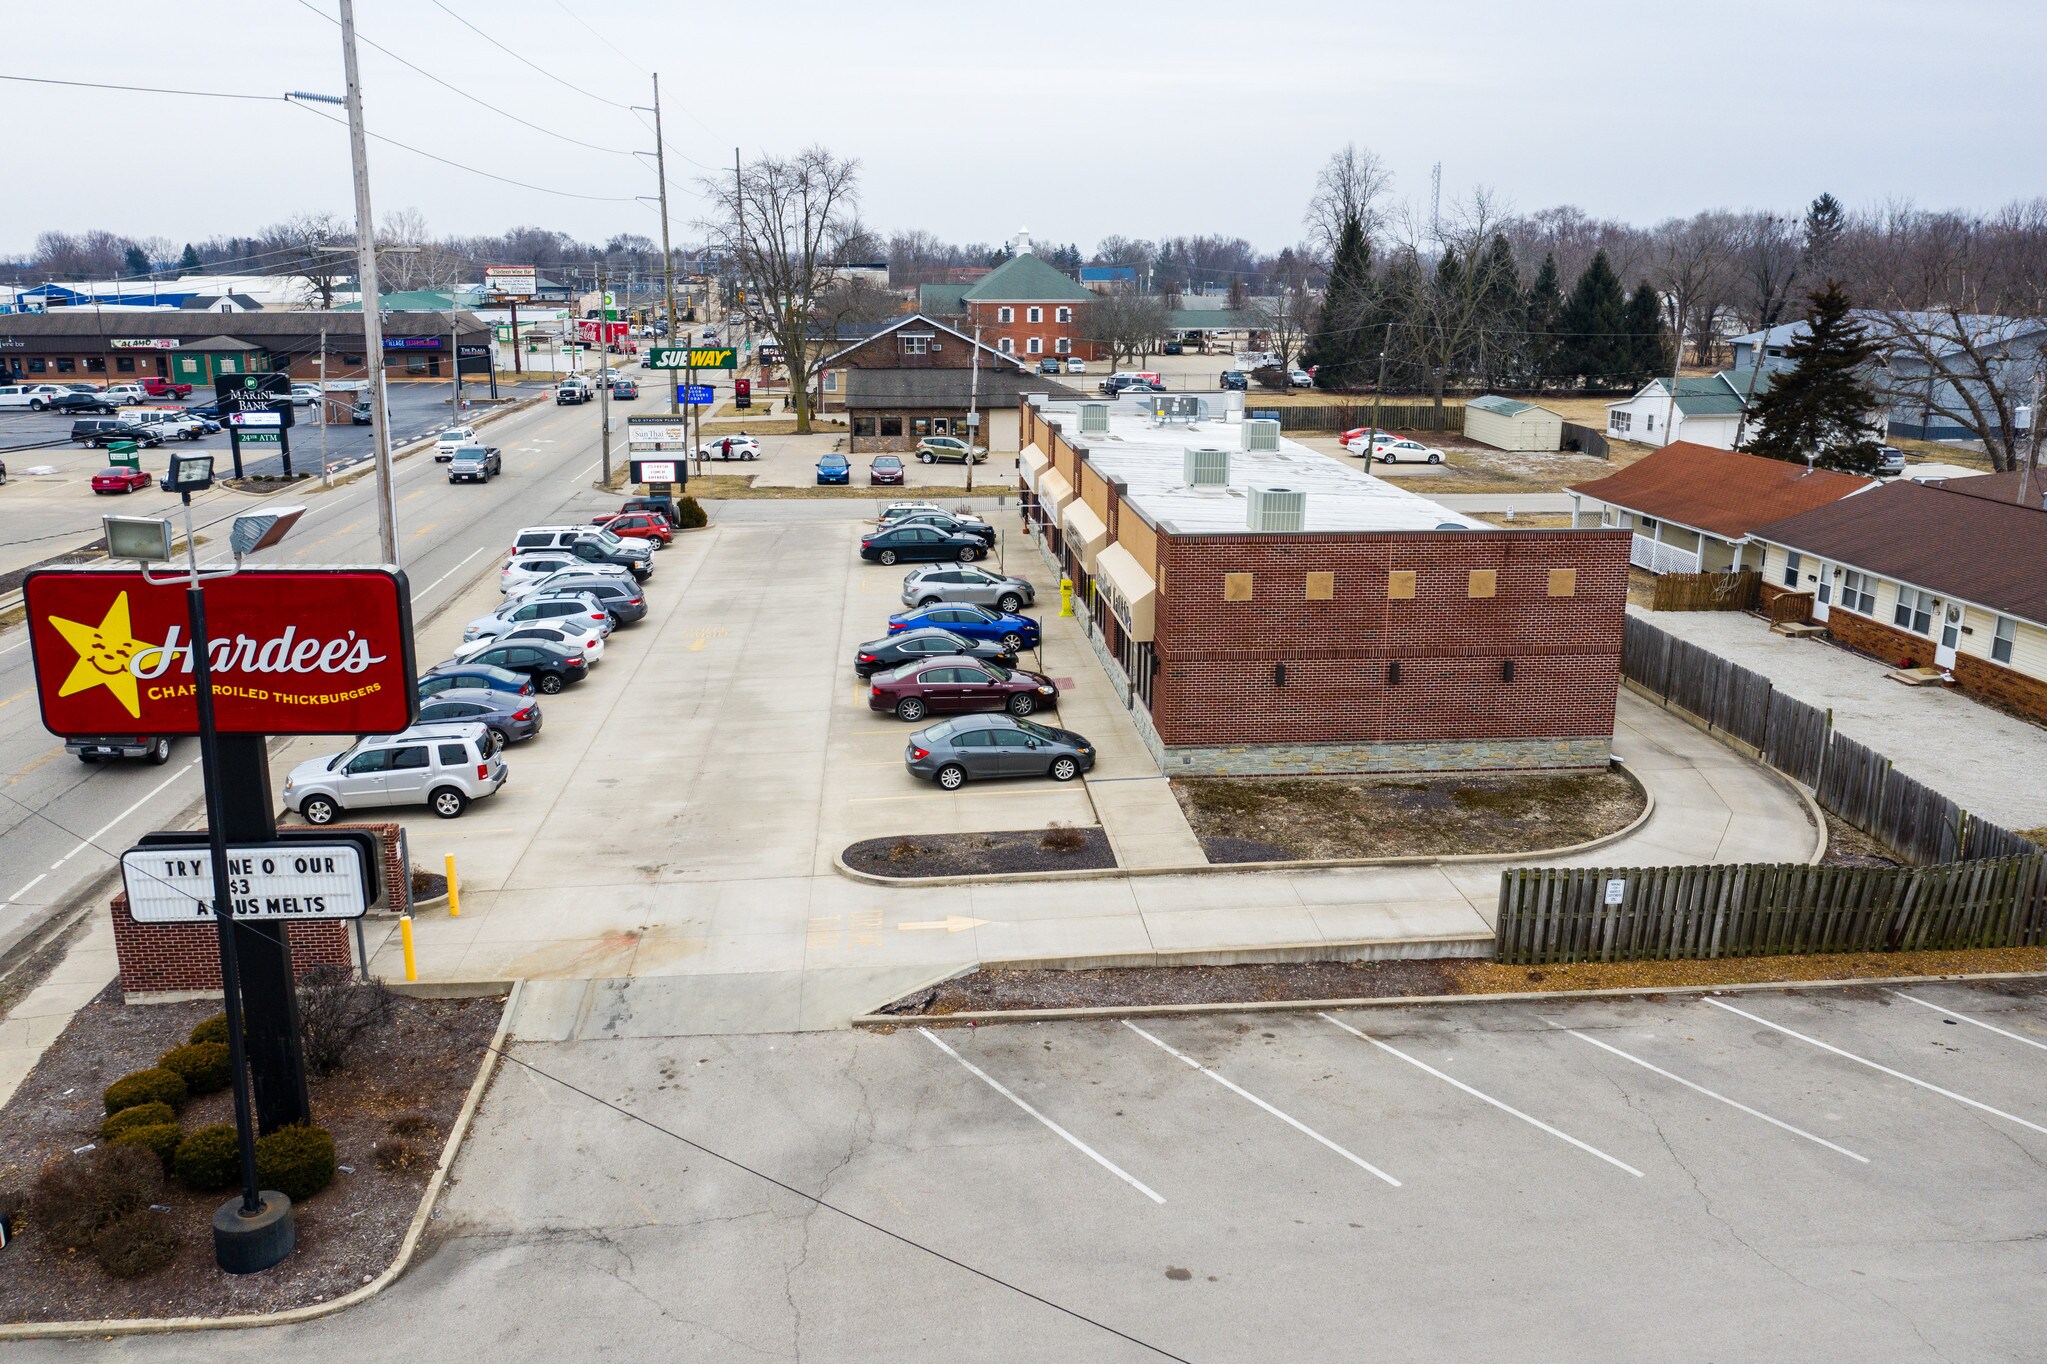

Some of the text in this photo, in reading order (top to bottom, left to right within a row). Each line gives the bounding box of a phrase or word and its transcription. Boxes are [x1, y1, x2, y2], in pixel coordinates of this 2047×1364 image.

[121, 339, 151, 347] ALAMO
[656, 350, 731, 367] SUBWAY
[230, 390, 274, 400] MARINE
[239, 400, 269, 411] BANK
[635, 430, 649, 438] Sun
[129, 625, 387, 680] Hardee's
[273, 682, 382, 705] THICKBURGERS
[165, 860, 202, 877] TRY
[228, 859, 253, 876] NE
[295, 857, 335, 874] OUR
[230, 879, 251, 895] $3
[266, 896, 326, 914] MELTS
